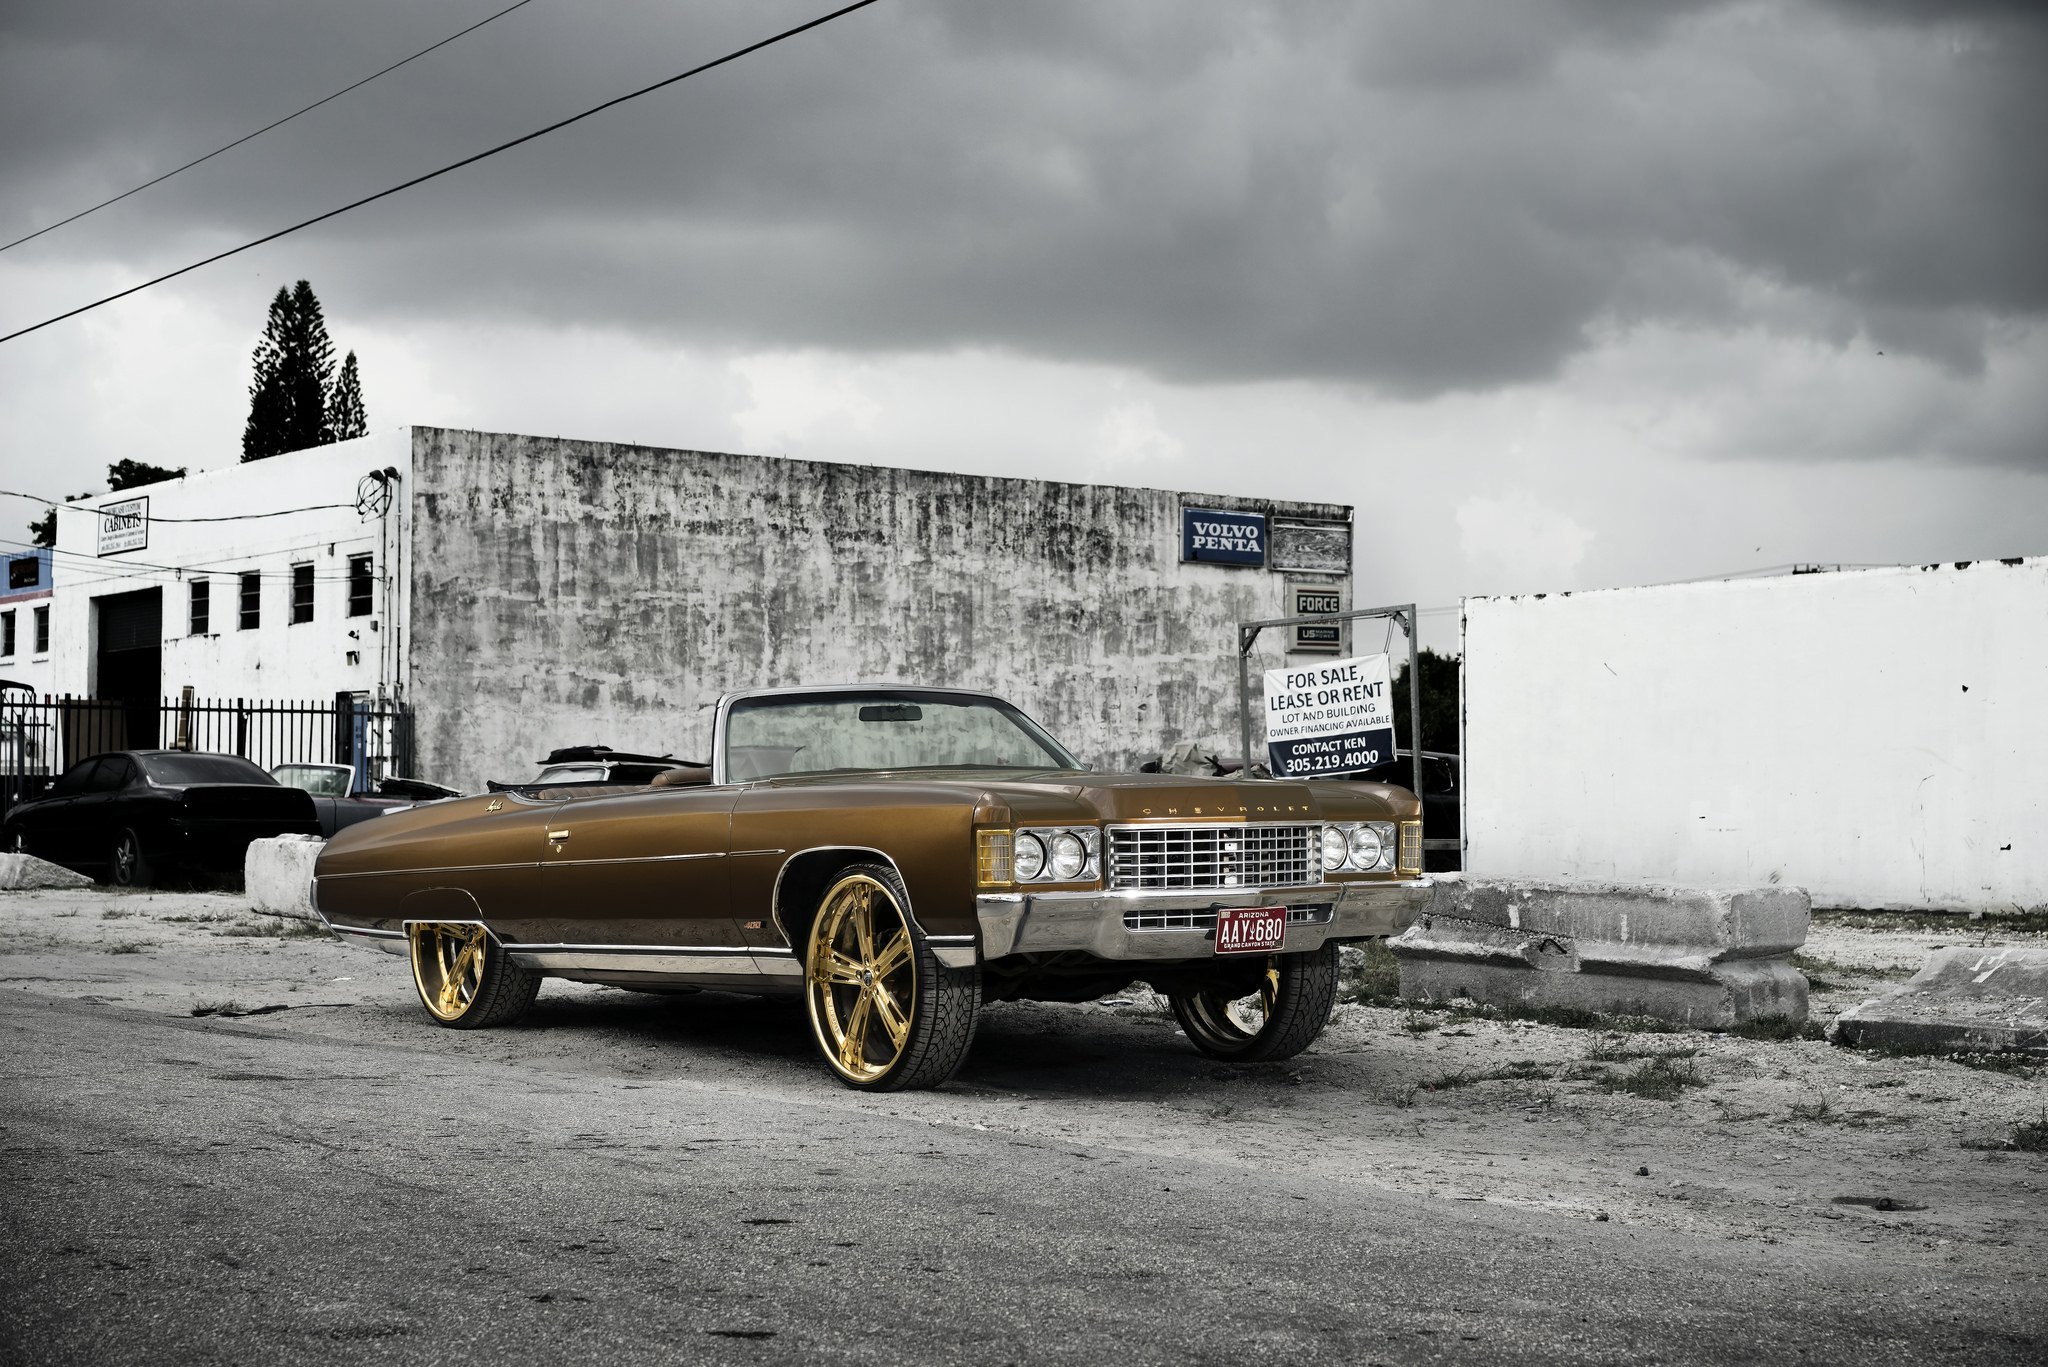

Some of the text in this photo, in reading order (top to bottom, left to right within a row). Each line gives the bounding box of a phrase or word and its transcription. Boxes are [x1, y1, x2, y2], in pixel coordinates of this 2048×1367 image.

[104, 511, 141, 533] CABINETS
[1193, 522, 1259, 539] VOLVO
[1192, 535, 1262, 553] PENTA
[1299, 597, 1338, 612] FORCE
[1302, 629, 1315, 638] US
[1287, 665, 1364, 690] FOR SALE,
[1270, 681, 1383, 711] LEASE OR RENT
[1282, 702, 1376, 724] LOT AND BUILDING
[1270, 714, 1390, 737] OWNER FINANCING AVAILABLE
[1292, 736, 1366, 755] CONTACT KEN
[1286, 749, 1379, 773] 305.219.4000
[1142, 805, 1309, 815] CHEVROLET
[1239, 911, 1269, 919] ARIZONA
[1221, 918, 1282, 943] AAY 680
